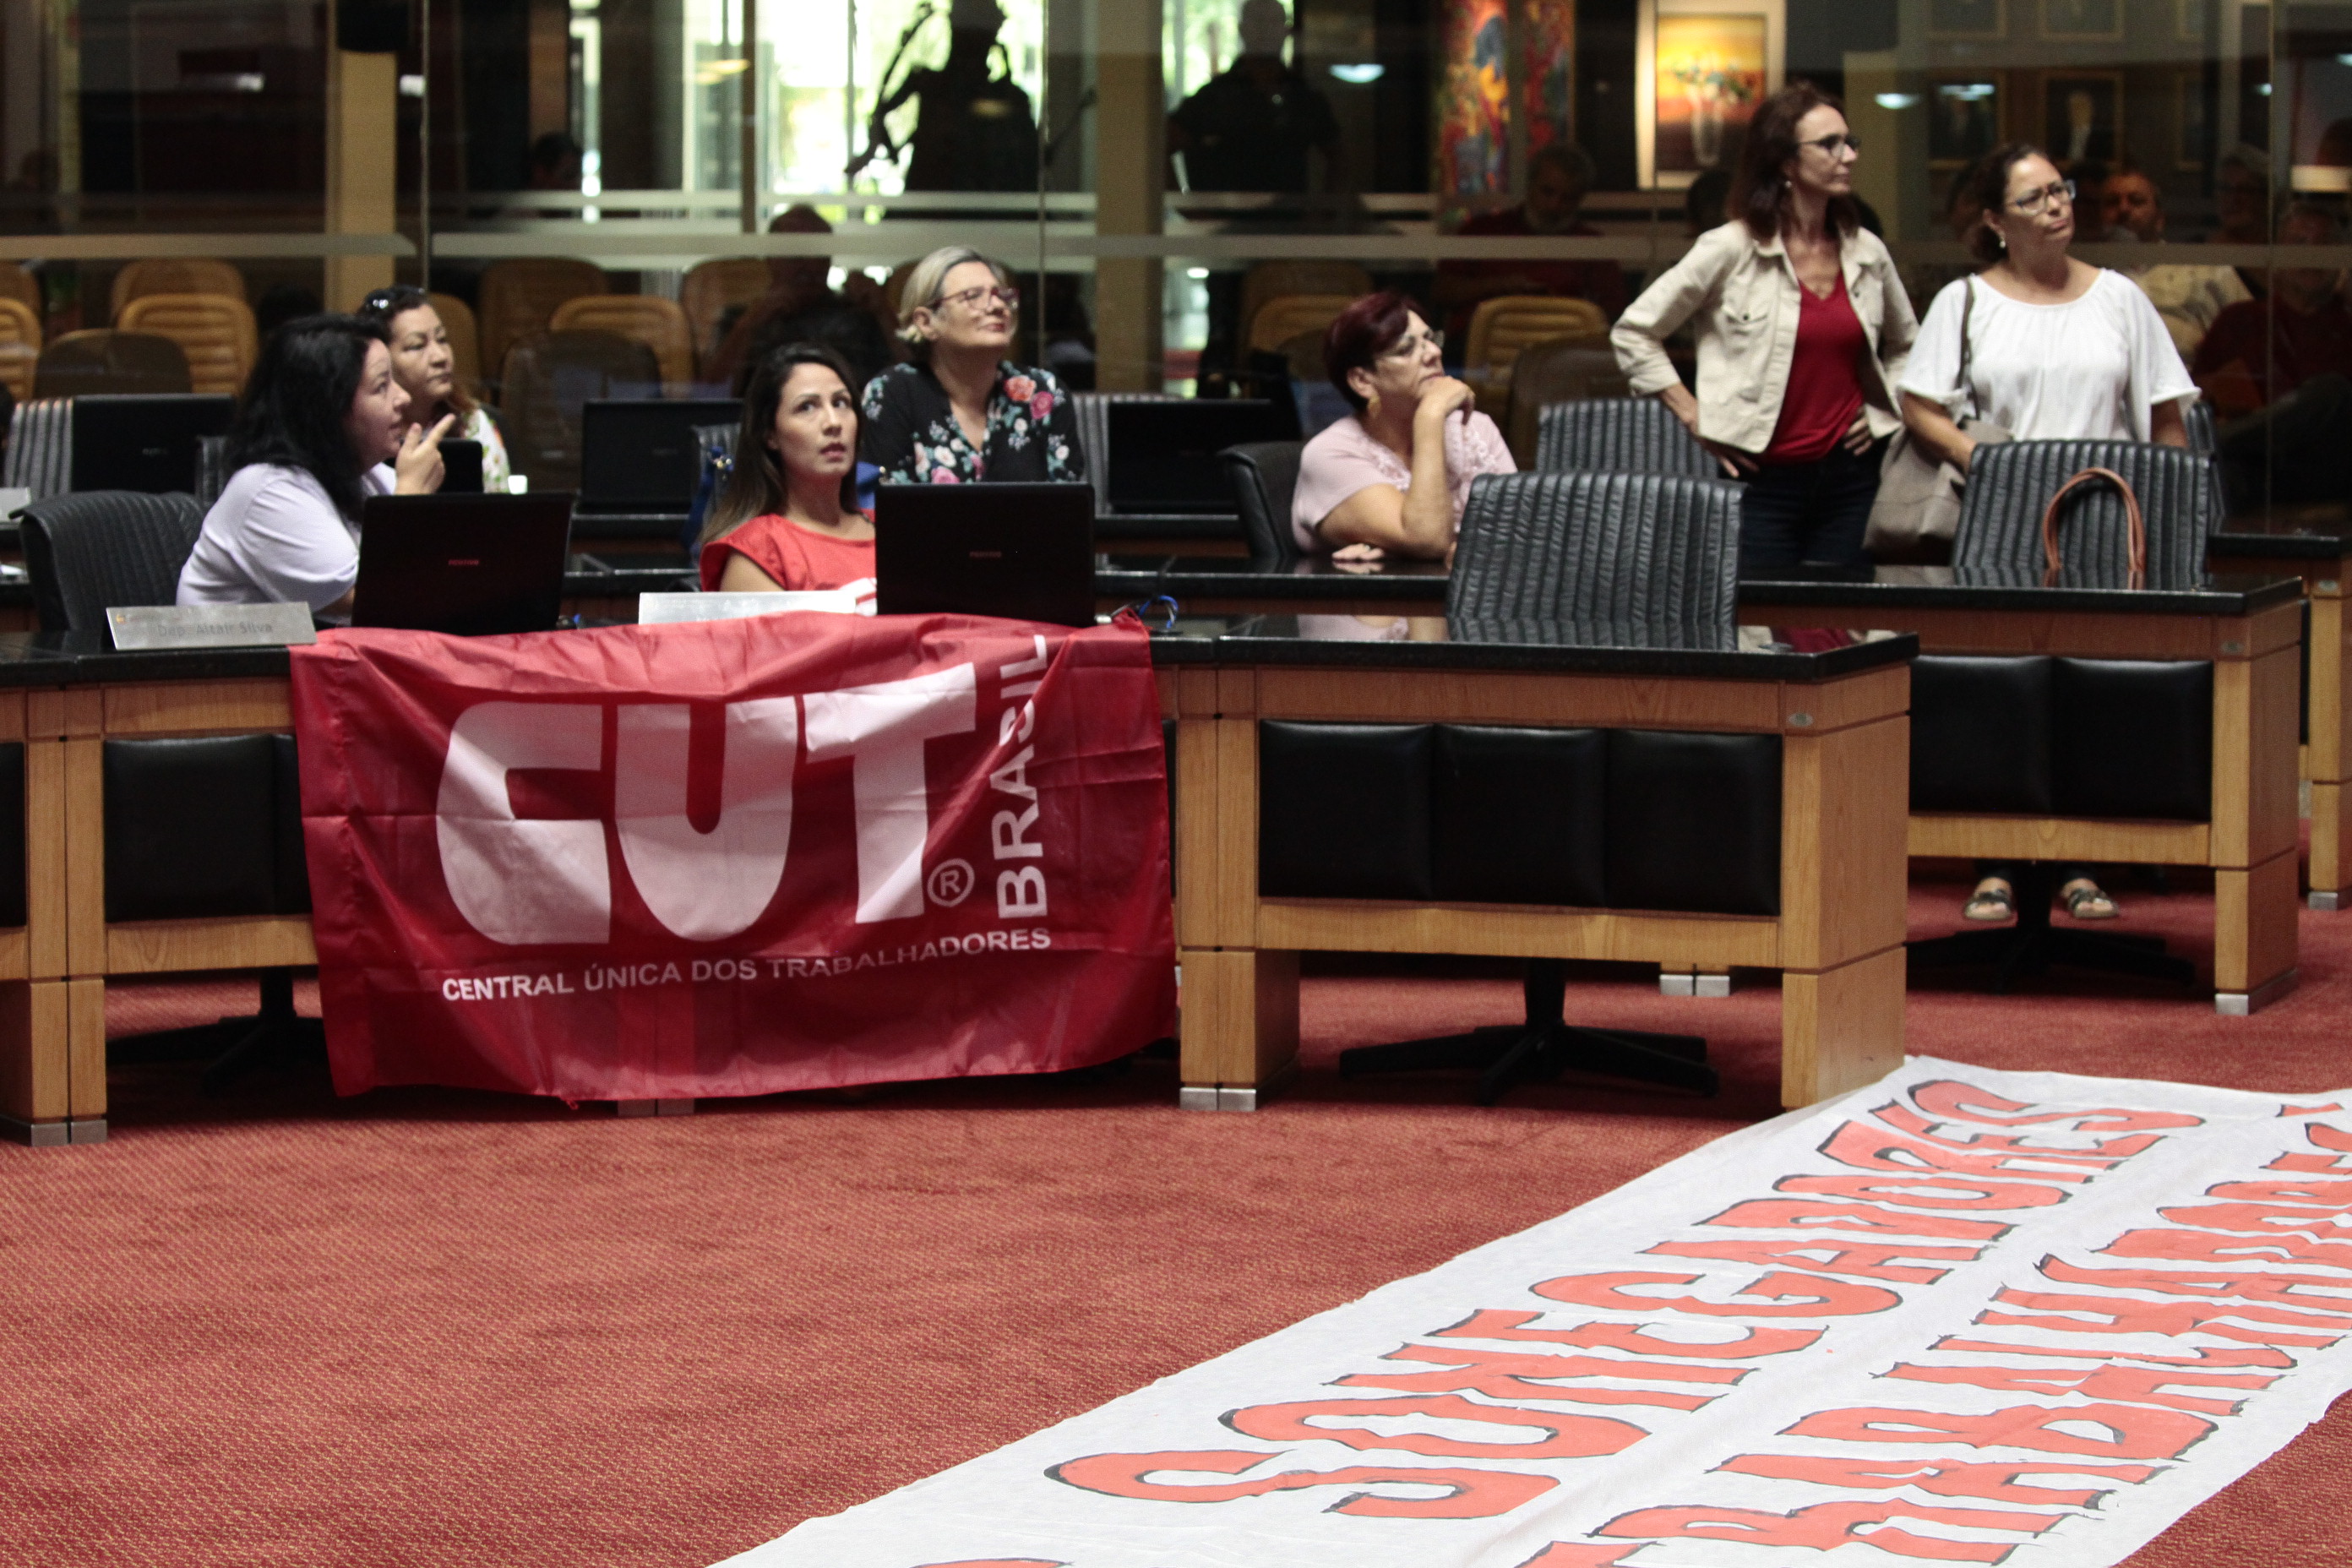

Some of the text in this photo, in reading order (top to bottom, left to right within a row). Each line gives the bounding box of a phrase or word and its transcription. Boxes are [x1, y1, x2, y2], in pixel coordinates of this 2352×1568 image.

[435, 662, 976, 945] CUT
[989, 634, 1048, 918] BRASIL
[443, 928, 1052, 1000] CENTRAL ÚNICA DOS TRABALHADORES
[1043, 1080, 2207, 1519] SONEGADORES
